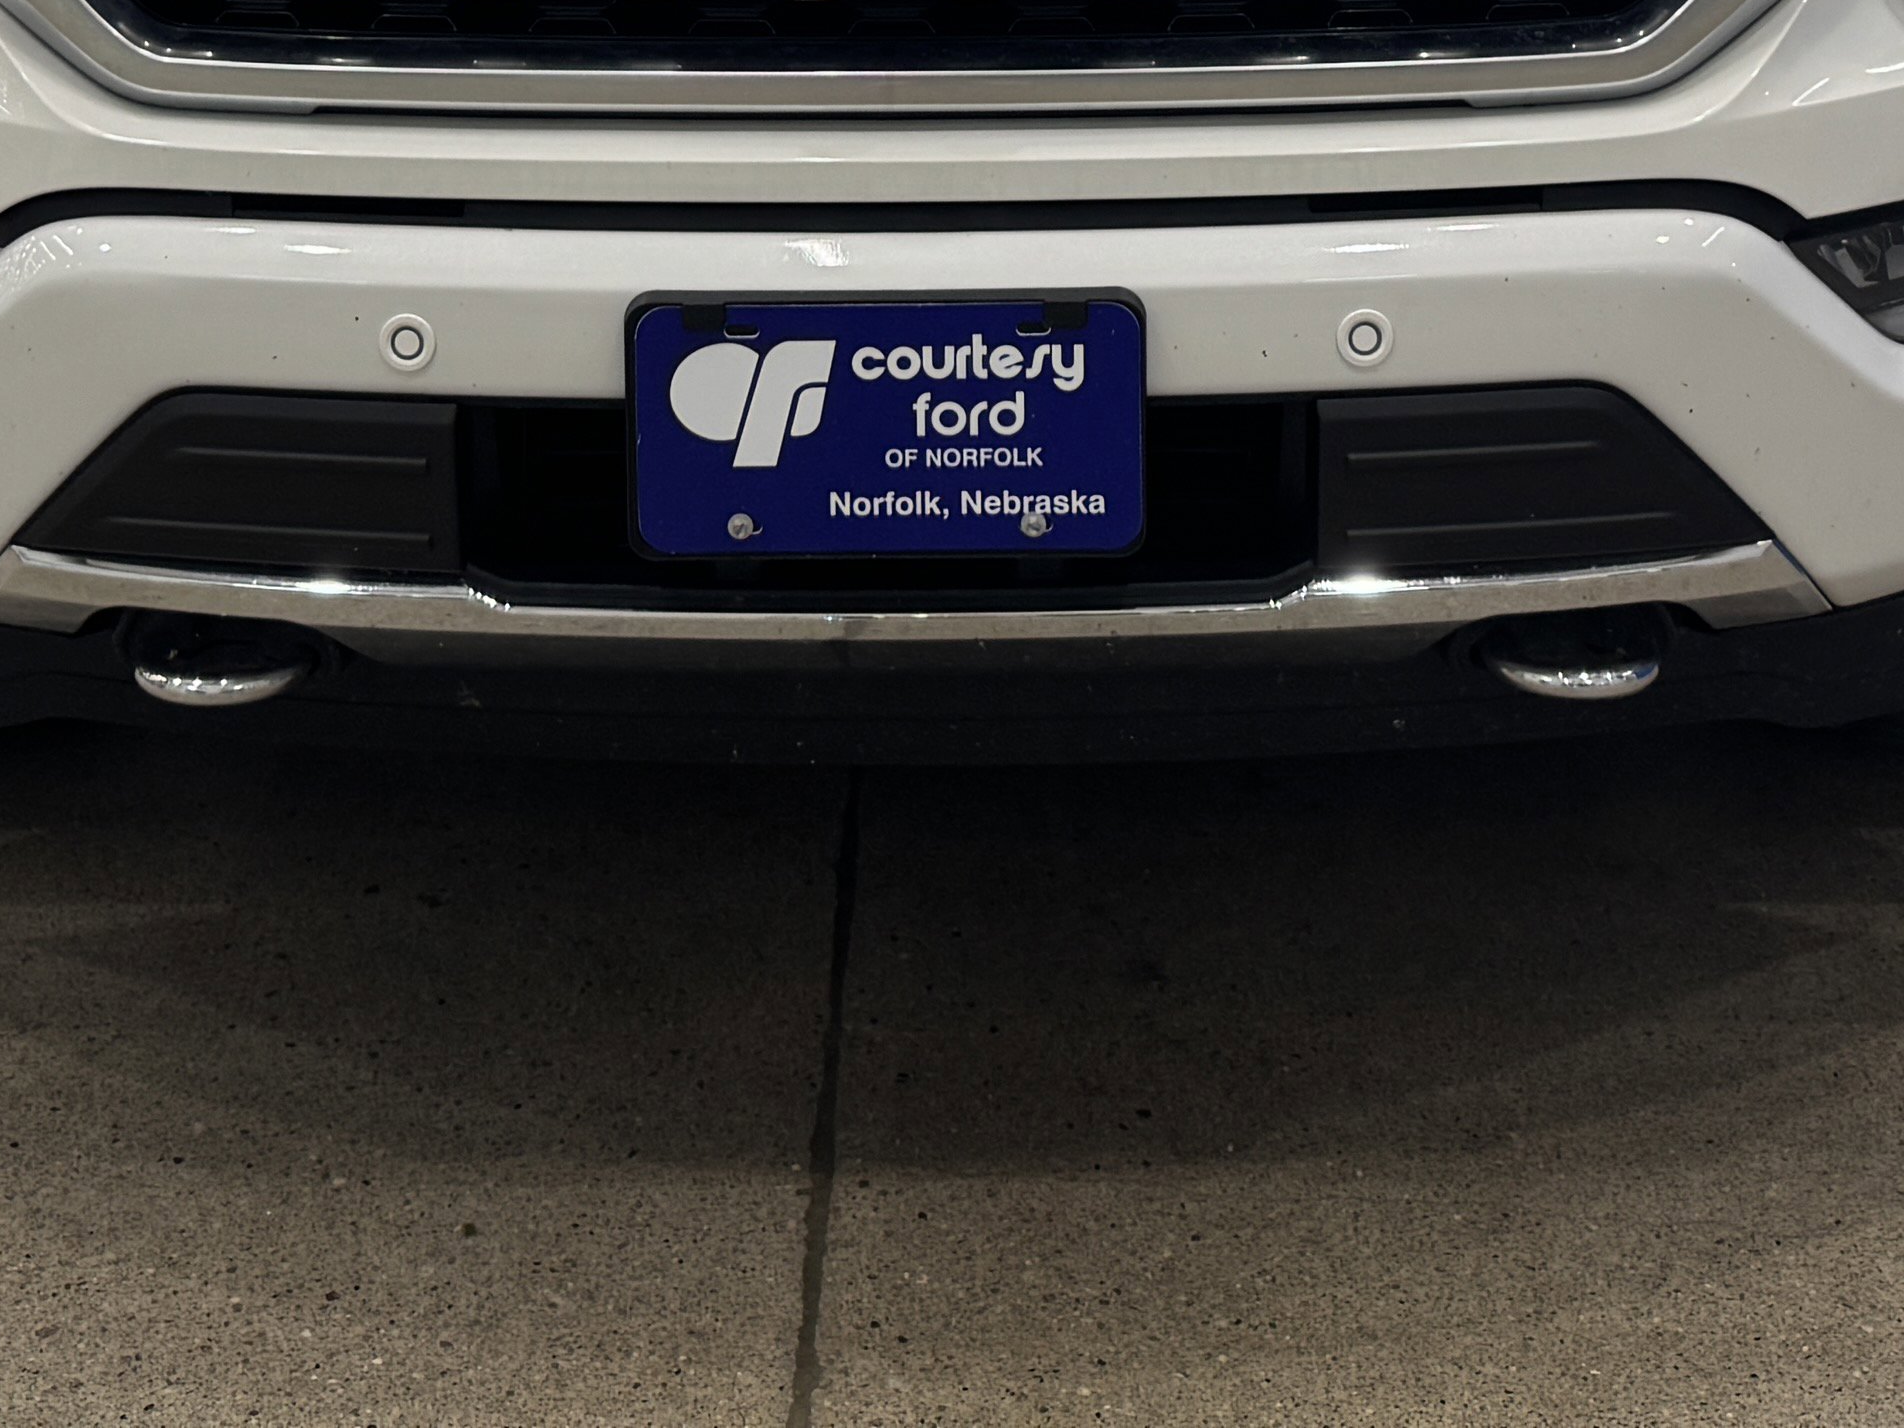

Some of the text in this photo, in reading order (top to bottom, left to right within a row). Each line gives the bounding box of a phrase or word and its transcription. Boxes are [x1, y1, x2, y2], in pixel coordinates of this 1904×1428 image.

[852, 334, 1084, 392] courtesy
[912, 391, 1025, 437] ford
[885, 447, 1043, 468] OF NORFOLK
[829, 490, 1106, 520] Norfolk, Nebraska
